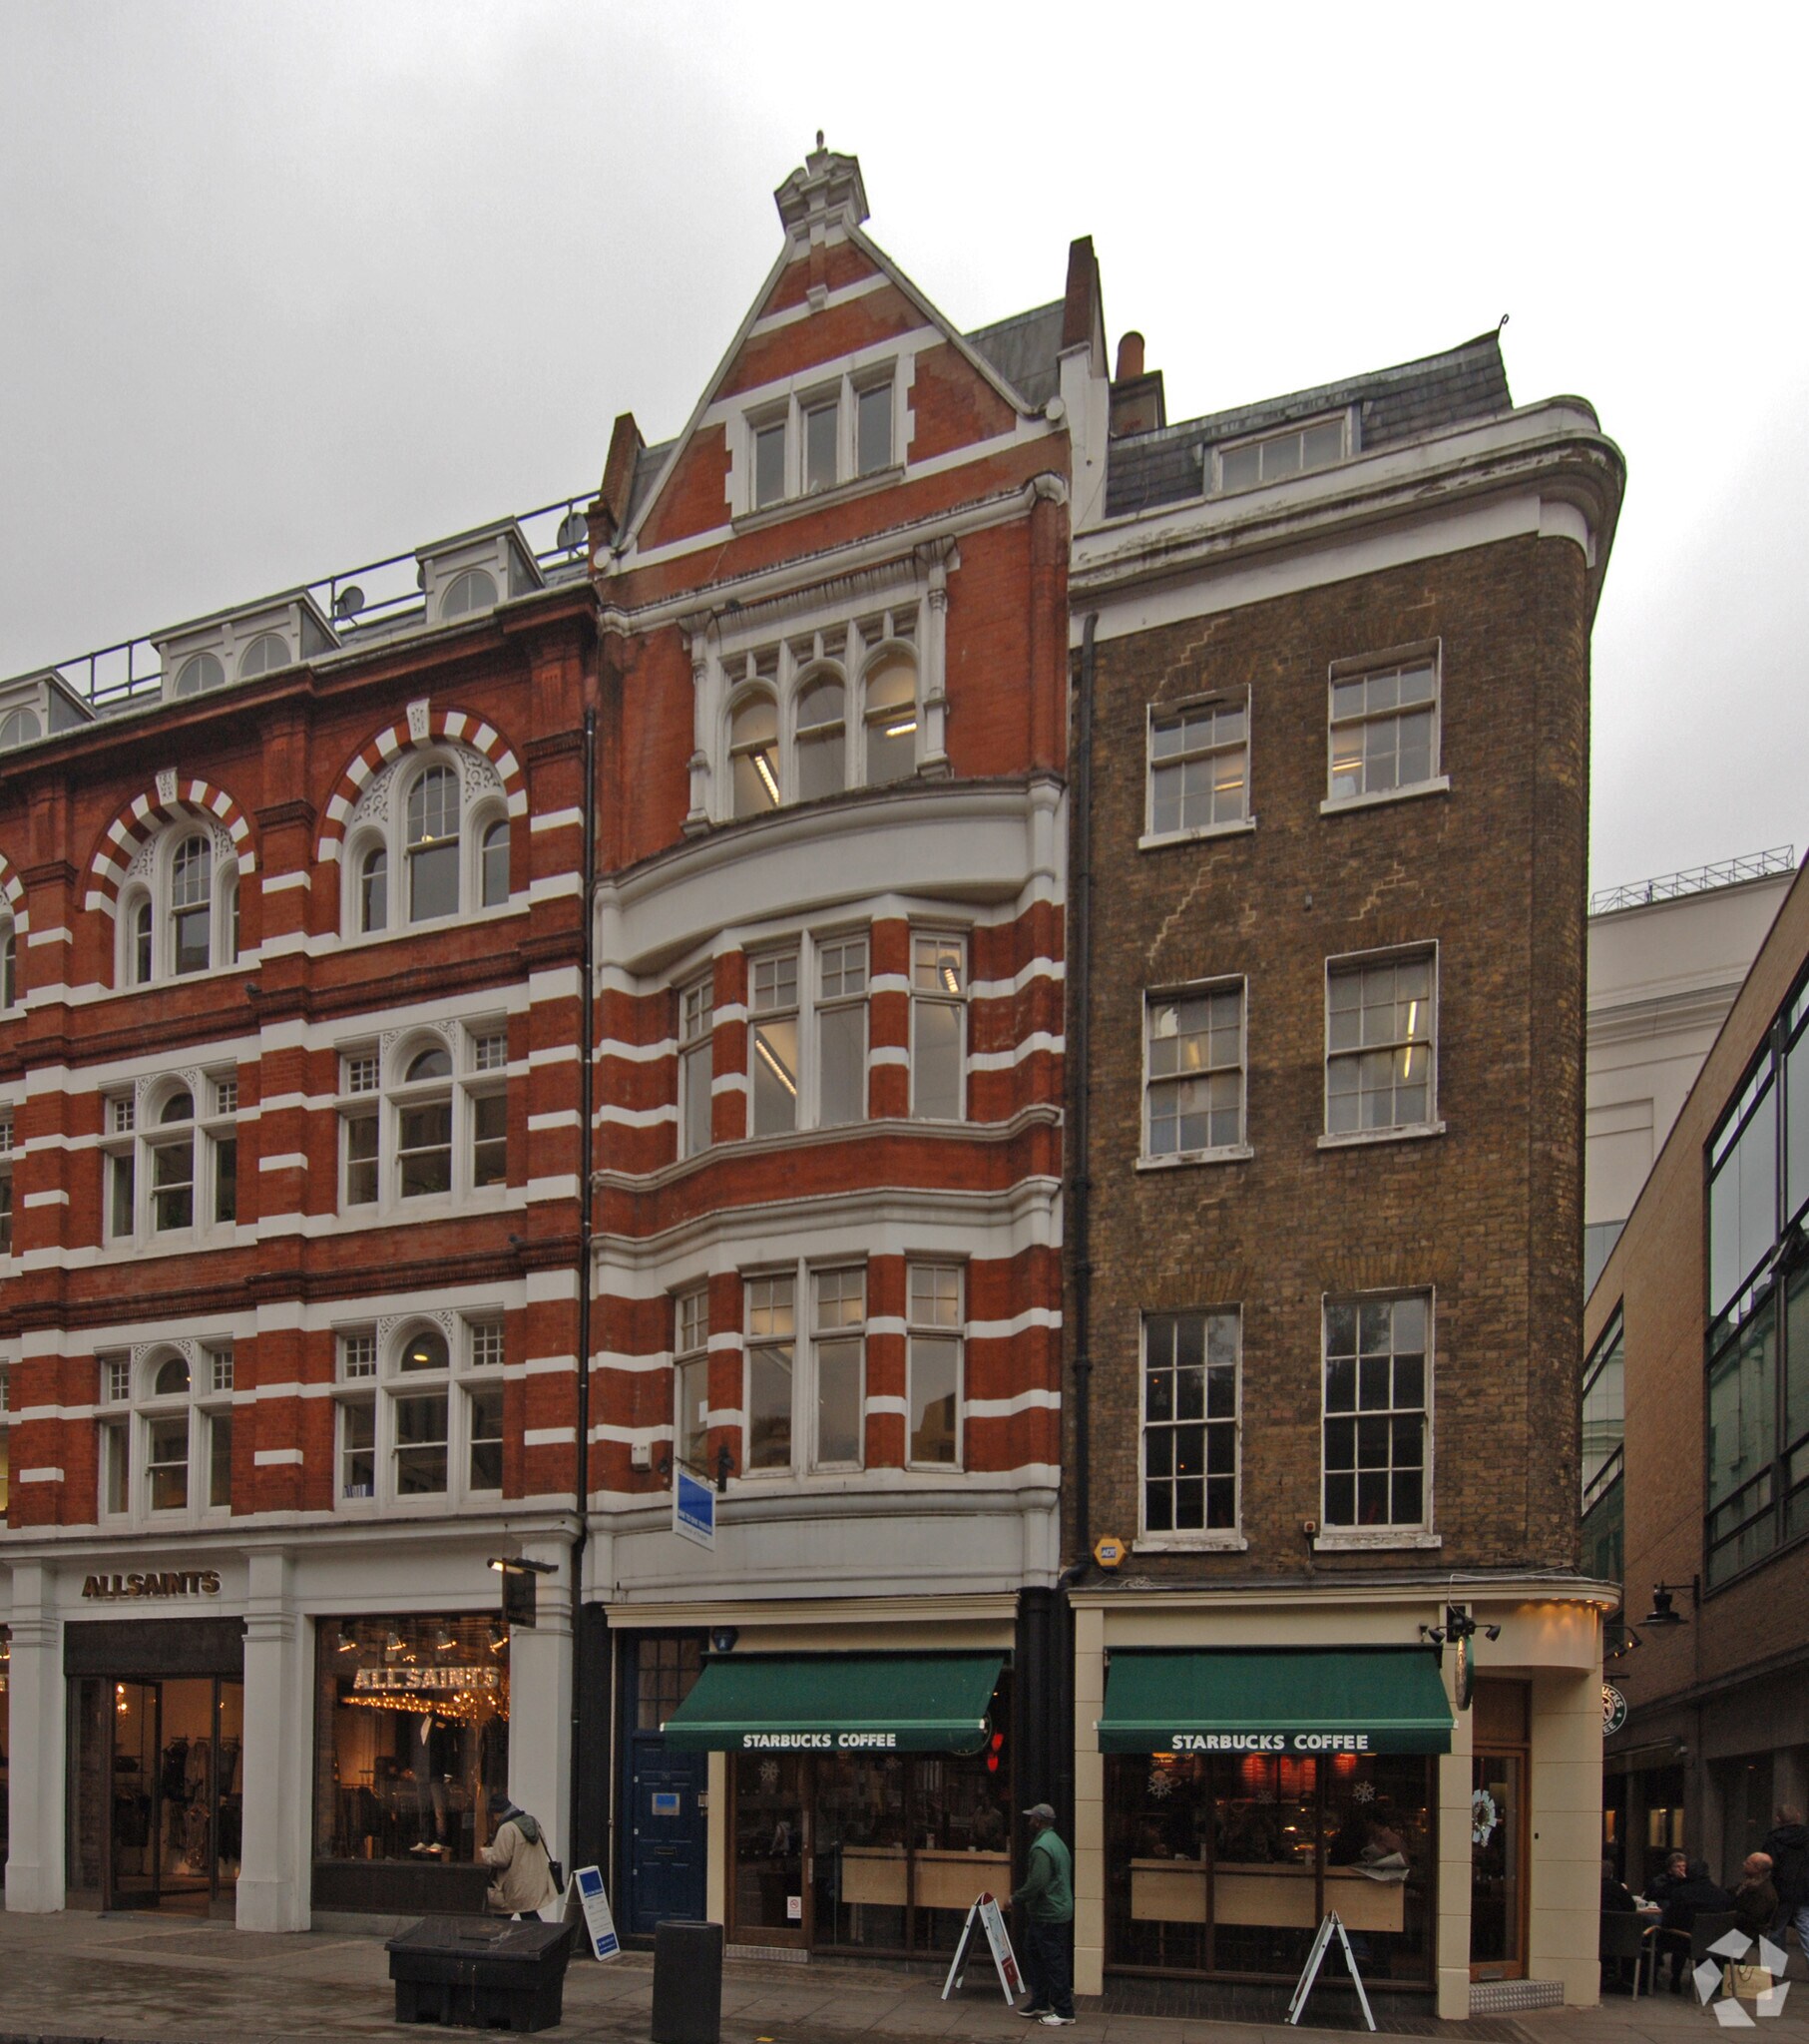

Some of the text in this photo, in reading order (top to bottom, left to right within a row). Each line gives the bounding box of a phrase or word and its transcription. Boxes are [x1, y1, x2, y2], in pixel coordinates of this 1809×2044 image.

[1102, 1548, 1116, 1557] ADT
[82, 1570, 221, 1597] ALLSAINTS
[743, 1734, 896, 1749] STARBUCKS COFFEE
[1171, 1735, 1368, 1750] STARBUCKS COFFEE
